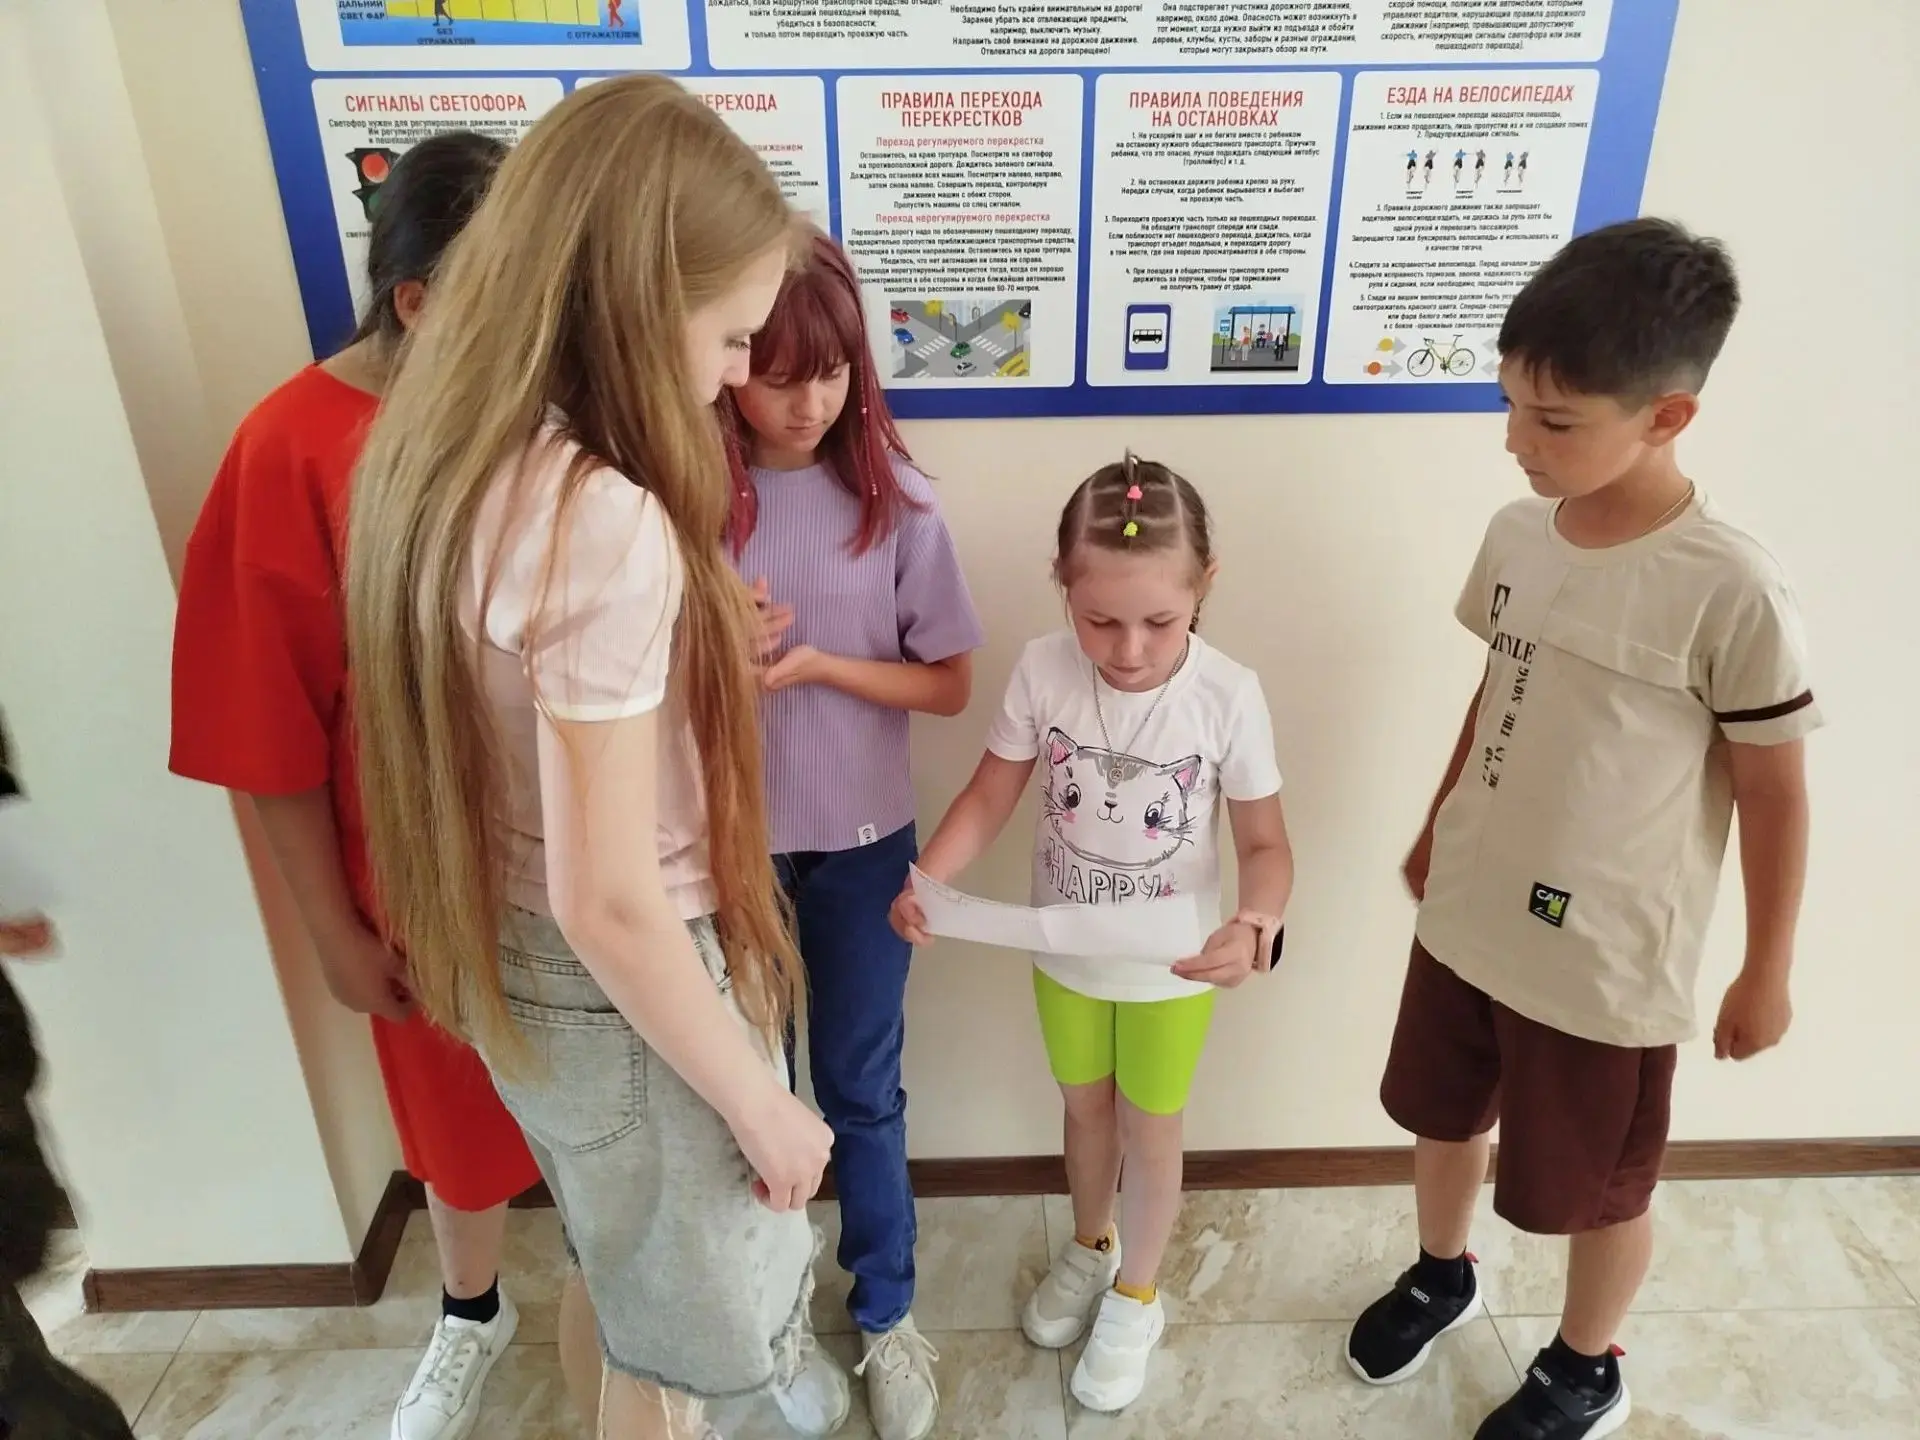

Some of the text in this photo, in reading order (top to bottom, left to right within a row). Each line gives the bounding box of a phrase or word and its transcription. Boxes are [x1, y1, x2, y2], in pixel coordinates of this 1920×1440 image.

[340, 12, 386, 20] СВЕТ ФАР
[981, 47, 1026, 55] Отвлекаться
[1066, 46, 1111, 56] запрещено!
[345, 94, 528, 112] СИГНАЛЫ СВЕТОФОРА
[697, 94, 778, 112] ЕРЕХОДА
[881, 92, 1042, 110] ПРАВИЛА ПЕРЕХОДА
[1129, 90, 1304, 108] ПРАВИЛА ПОВЕДЕНИЯ
[1387, 85, 1574, 106] ЕЗДА НА ВЕЛОСИПЕДАХ
[902, 111, 1023, 127] ПЕРЕКРЕСТКОВ
[1152, 109, 1278, 127] НА ОСТАНОВКАХ
[876, 136, 1044, 147] Переход регулируемого перекрестка
[876, 213, 1050, 224] Переход нерегулируемого перекрестка
[1500, 710, 1516, 737] THE
[1049, 837, 1162, 904] HAPPY
